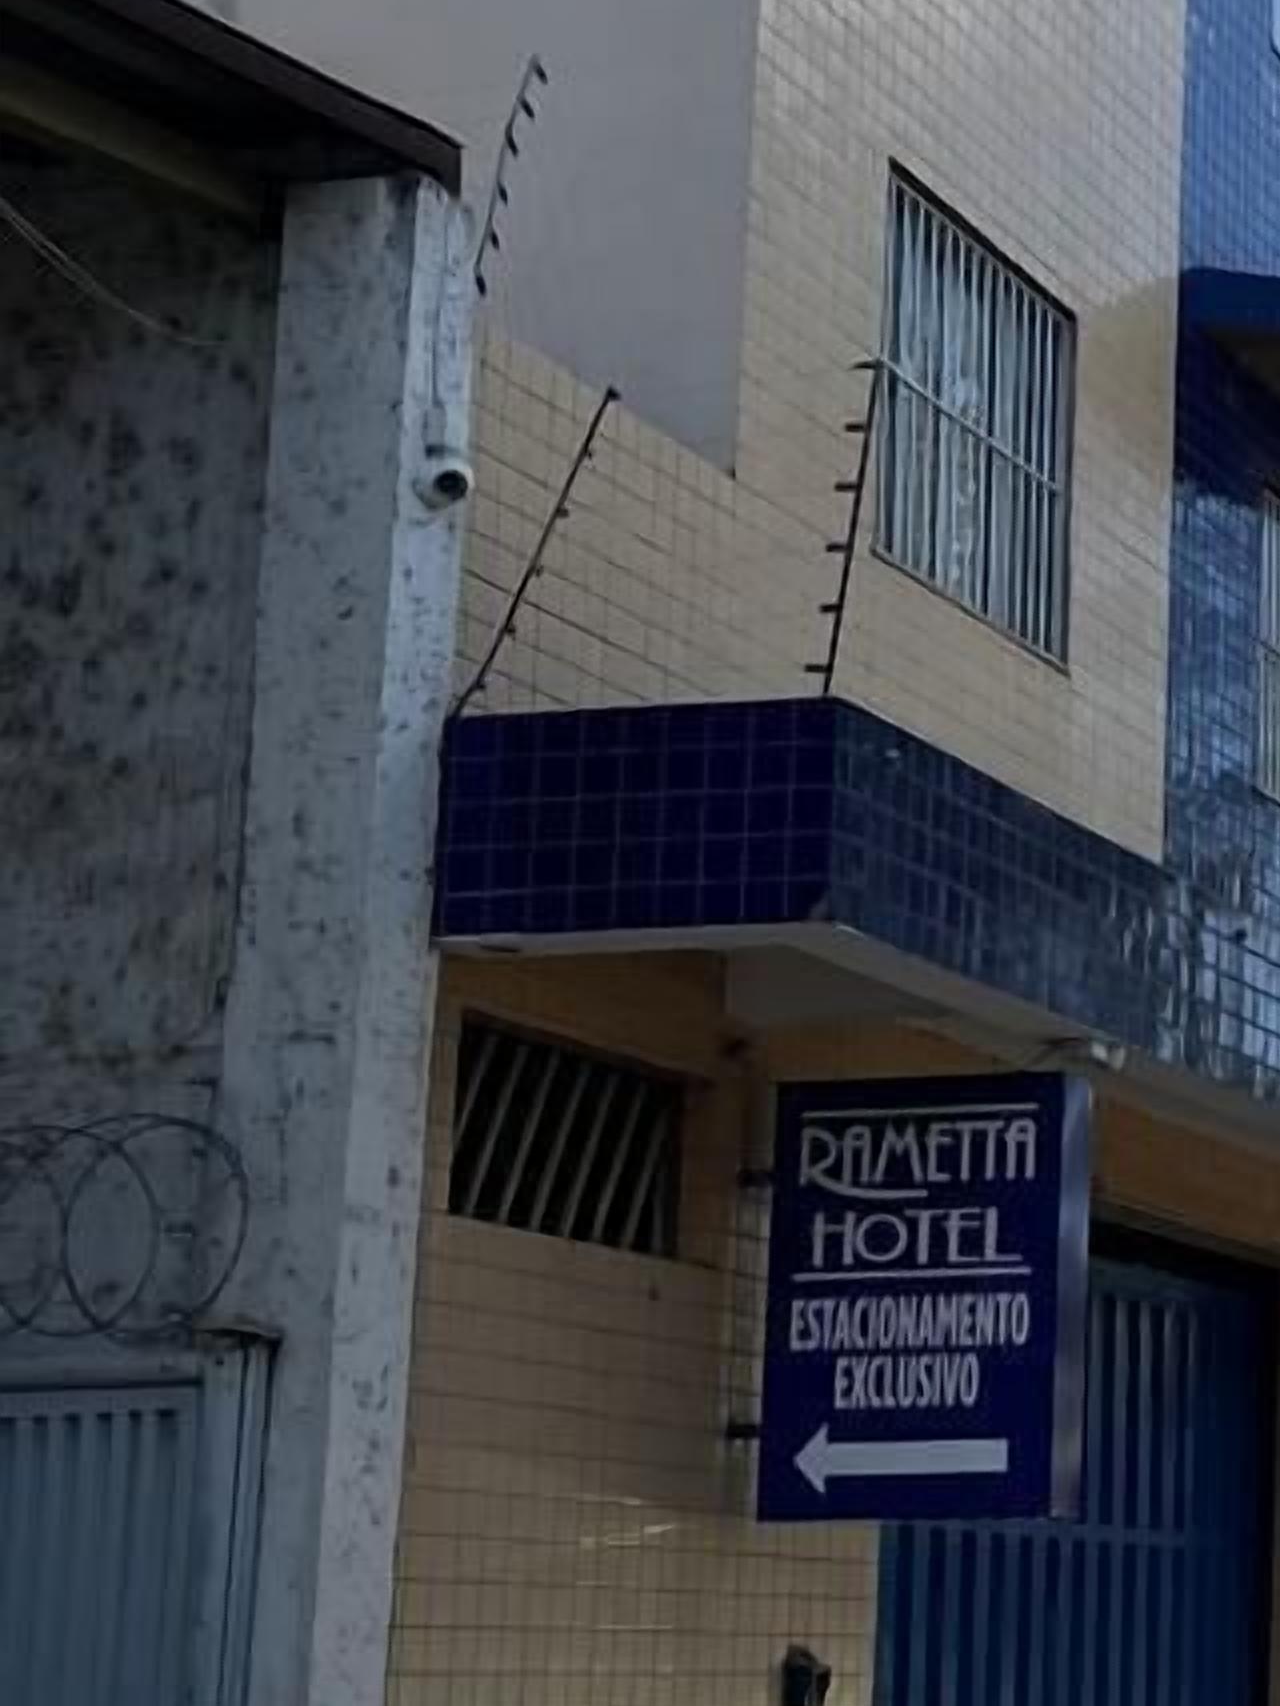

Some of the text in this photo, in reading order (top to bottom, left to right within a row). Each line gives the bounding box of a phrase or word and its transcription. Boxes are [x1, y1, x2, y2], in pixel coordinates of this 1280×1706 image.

[800, 1119, 1036, 1198] RAMETTA
[811, 1207, 1023, 1267] HOTEL
[790, 1292, 1030, 1352] ESTACIONAMENTO
[834, 1353, 980, 1409] EXCLUSIVO
